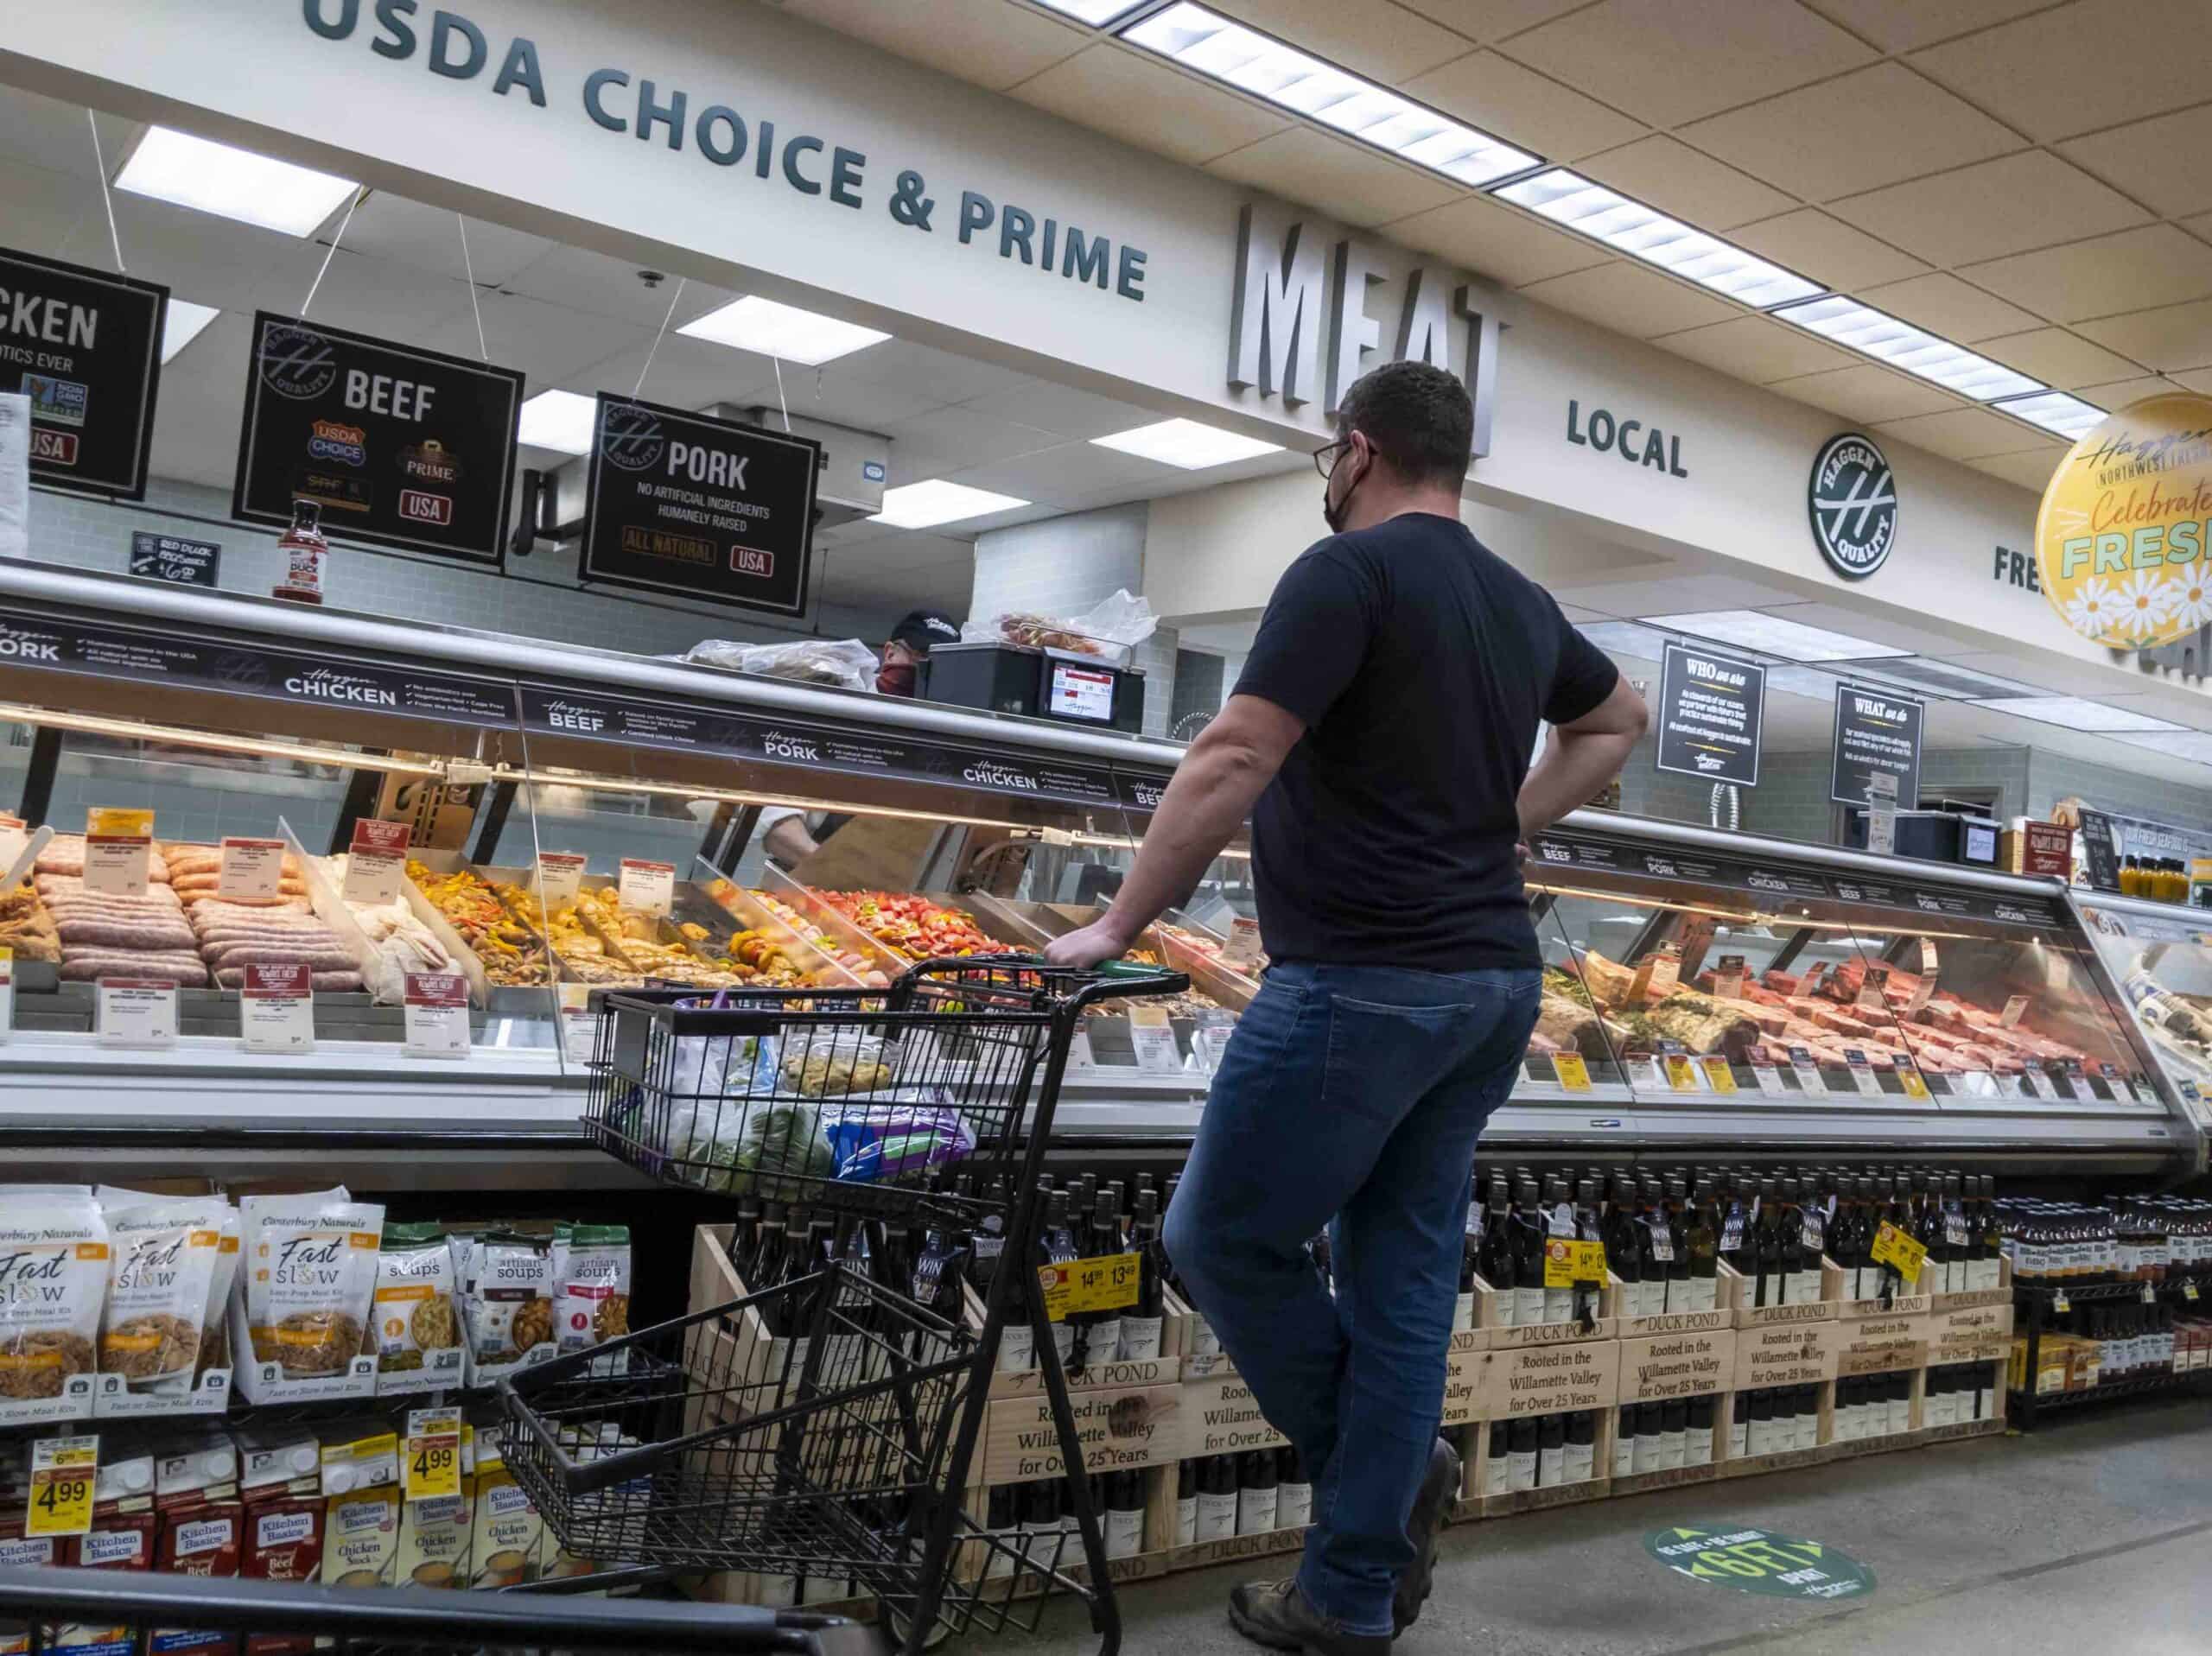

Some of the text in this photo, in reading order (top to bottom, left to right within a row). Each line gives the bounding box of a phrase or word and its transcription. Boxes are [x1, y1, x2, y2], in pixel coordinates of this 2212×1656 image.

[302, 0, 1147, 301] USDA CHOICE & PRIME
[0, 345, 73, 371] TICS EVER
[346, 370, 435, 422] BEEF
[319, 426, 359, 443] USDA
[1567, 400, 1688, 479] LOCAL
[312, 440, 360, 458] CHOICE
[407, 460, 454, 480] PRIME
[667, 441, 749, 491] PORK
[1823, 446, 1876, 490] HAGGEN
[2100, 457, 2168, 485] NORTHWEST
[410, 495, 441, 518] USA
[637, 482, 770, 519] NO ARTIFICIAL INGREDIENTS
[658, 504, 747, 533] HUMANELY RAISED
[626, 528, 713, 562] ALL NATURAL
[1838, 515, 1890, 562] QUALITY
[2061, 518, 2212, 580] FRES
[739, 550, 765, 572] USA
[1994, 546, 2045, 595] FRE
[1687, 657, 1716, 679] WHO
[284, 678, 397, 706] CHICKEN
[550, 713, 604, 732] BEEF
[765, 742, 820, 761] PORK
[963, 768, 1038, 790] CHICKEN
[1542, 848, 1571, 861] BEEF
[1651, 1228, 1669, 1239] WIN
[1726, 1219, 1745, 1230] WIN
[124, 1238, 184, 1273] Fast
[279, 1237, 343, 1269] Fast
[498, 1266, 544, 1279] soups
[918, 1257, 944, 1276] WIN
[1764, 1302, 1827, 1322] DUCK POND
[1895, 1297, 1923, 1311] POND
[1647, 1311, 1720, 1332] DUCK POND
[1859, 1320, 1910, 1336] Rooted in the
[1522, 1324, 1560, 1342] DUCK
[1762, 1330, 1818, 1345] Rooted in the
[1649, 1339, 1712, 1357] Rooted in the
[1751, 1348, 1799, 1365] Willamette
[1522, 1351, 1592, 1369] Rooted in the
[1638, 1357, 1720, 1380] Willamette Valley
[1103, 1361, 1159, 1384] POND
[1509, 1370, 1603, 1391] Willamette Valley
[1751, 1366, 1822, 1383] for Over 25 Years
[1638, 1379, 1716, 1398] for Over 25 Years
[1509, 1393, 1598, 1412] for Over 25 Years
[1018, 1427, 1105, 1450] Willaette
[1205, 1433, 1225, 1450] for
[1228, 1431, 1262, 1447] Over
[1018, 1449, 1148, 1475] for 25 Years
[341, 1504, 385, 1520] Kitchen
[263, 1518, 309, 1532] Kitchen
[345, 1516, 381, 1528] Basics
[86, 1533, 137, 1549] Kitchen
[181, 1524, 227, 1541] Kitchen
[267, 1528, 304, 1542] Basics
[415, 1534, 456, 1549] Chicken
[488, 1525, 528, 1539] Chicken
[184, 1535, 222, 1550] Basics
[338, 1543, 380, 1558] Chicken
[92, 1547, 131, 1558] Basics
[1697, 1540, 1815, 1577] 6FT
[188, 1564, 213, 1577] Beef
[269, 1557, 294, 1570] Beef
